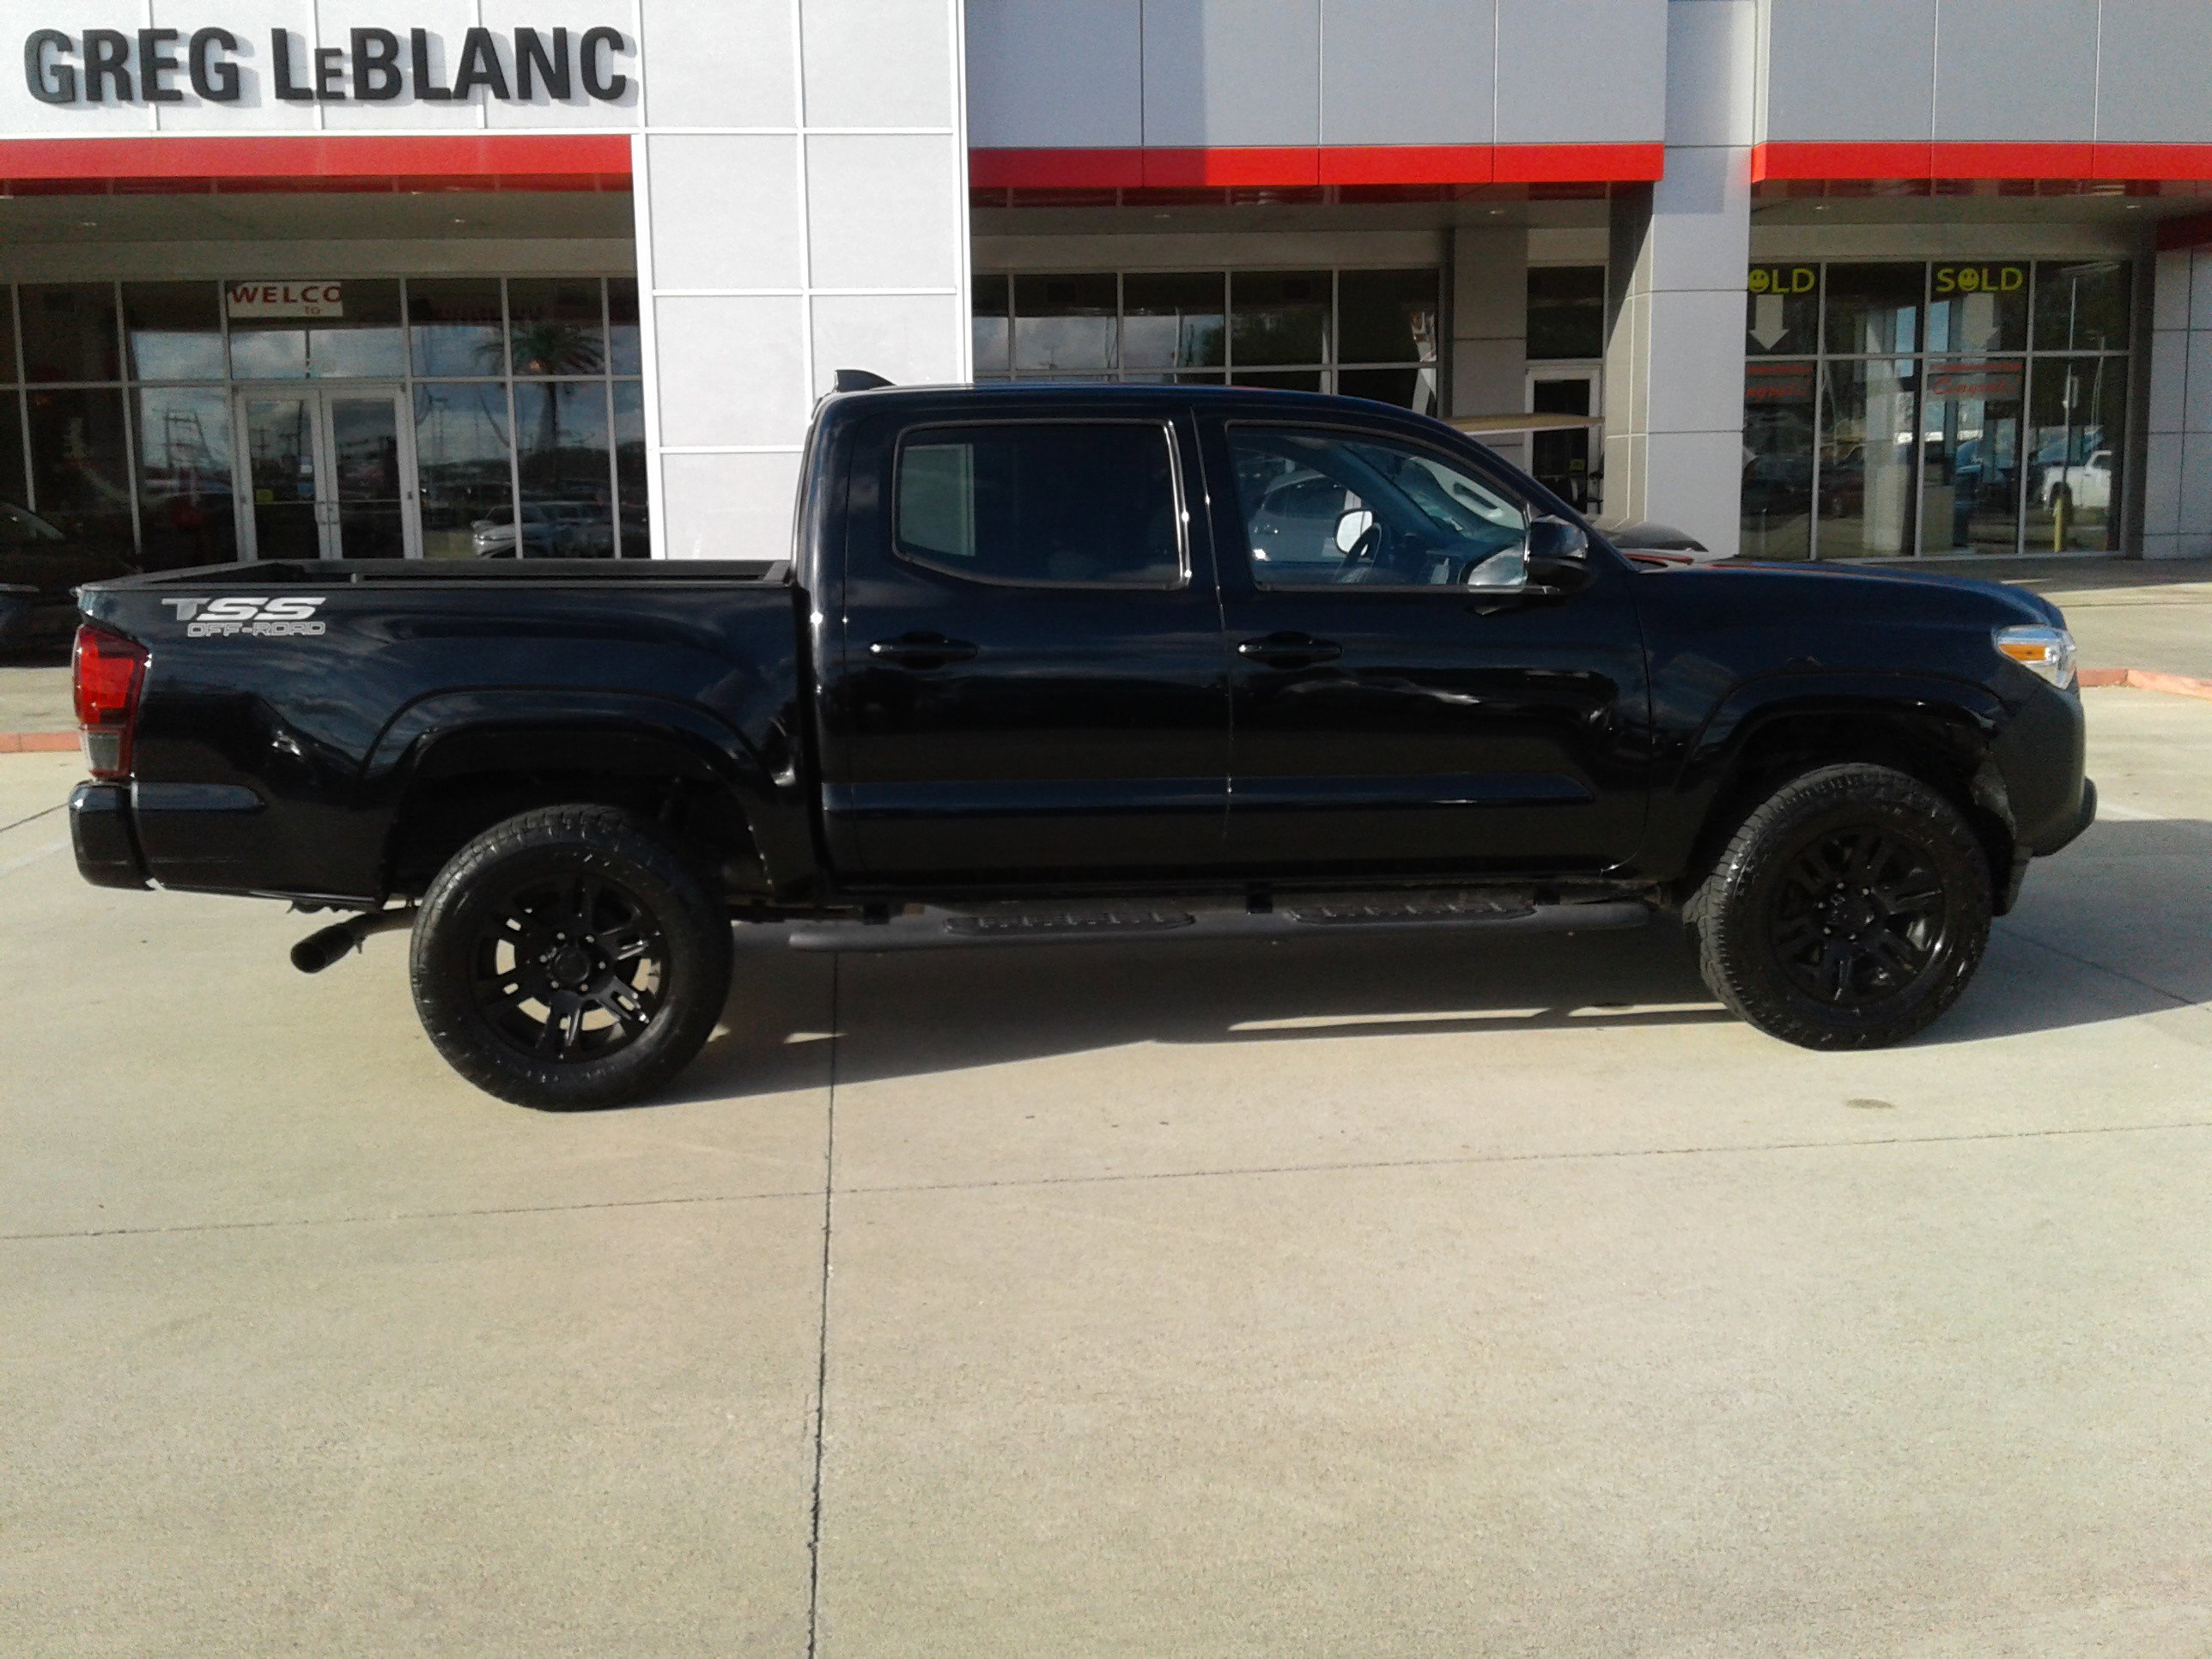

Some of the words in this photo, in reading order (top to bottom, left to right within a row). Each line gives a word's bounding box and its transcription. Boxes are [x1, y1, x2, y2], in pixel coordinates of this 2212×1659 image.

[24, 27, 240, 104] GREG
[1748, 267, 1815, 293] OLD
[1936, 267, 2024, 292] SOLD
[231, 285, 343, 304] WELCO
[161, 597, 327, 621] TSS
[186, 621, 326, 637] OFF-ROAD
